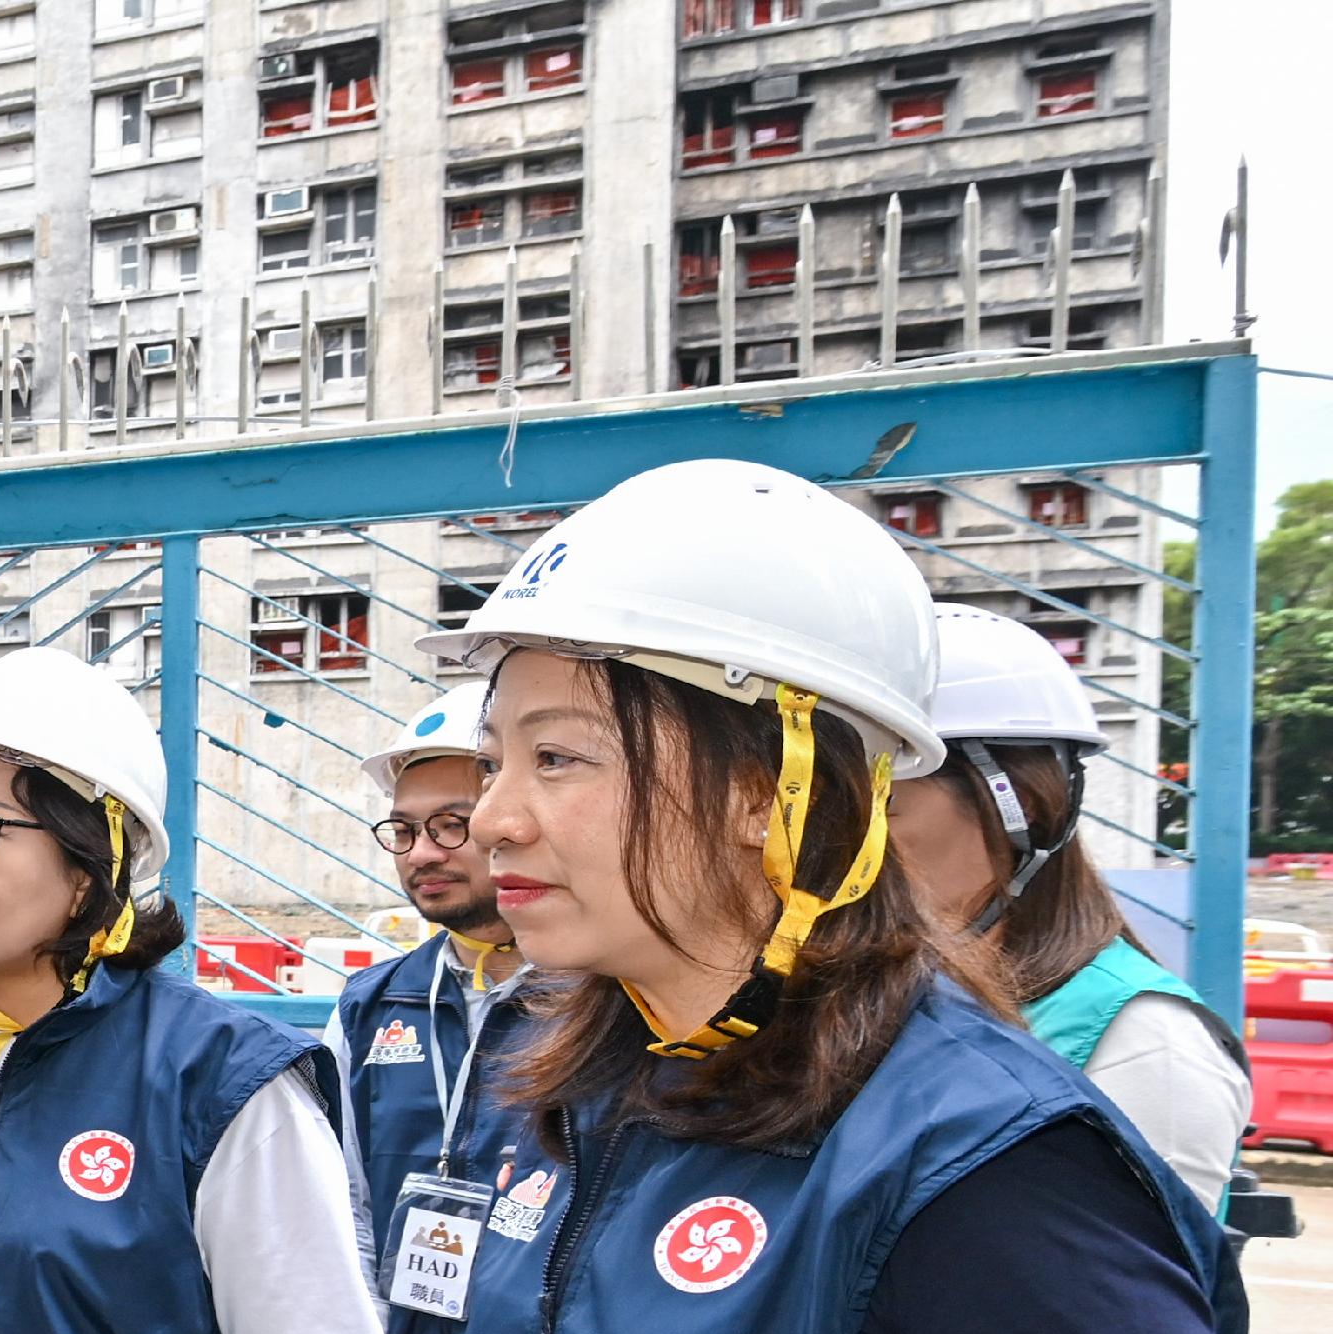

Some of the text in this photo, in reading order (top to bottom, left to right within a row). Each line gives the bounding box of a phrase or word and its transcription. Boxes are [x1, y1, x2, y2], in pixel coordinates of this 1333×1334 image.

[502, 587, 539, 599] KOREL
[407, 1253, 459, 1279] HAD
[410, 1282, 445, 1306] 職員
